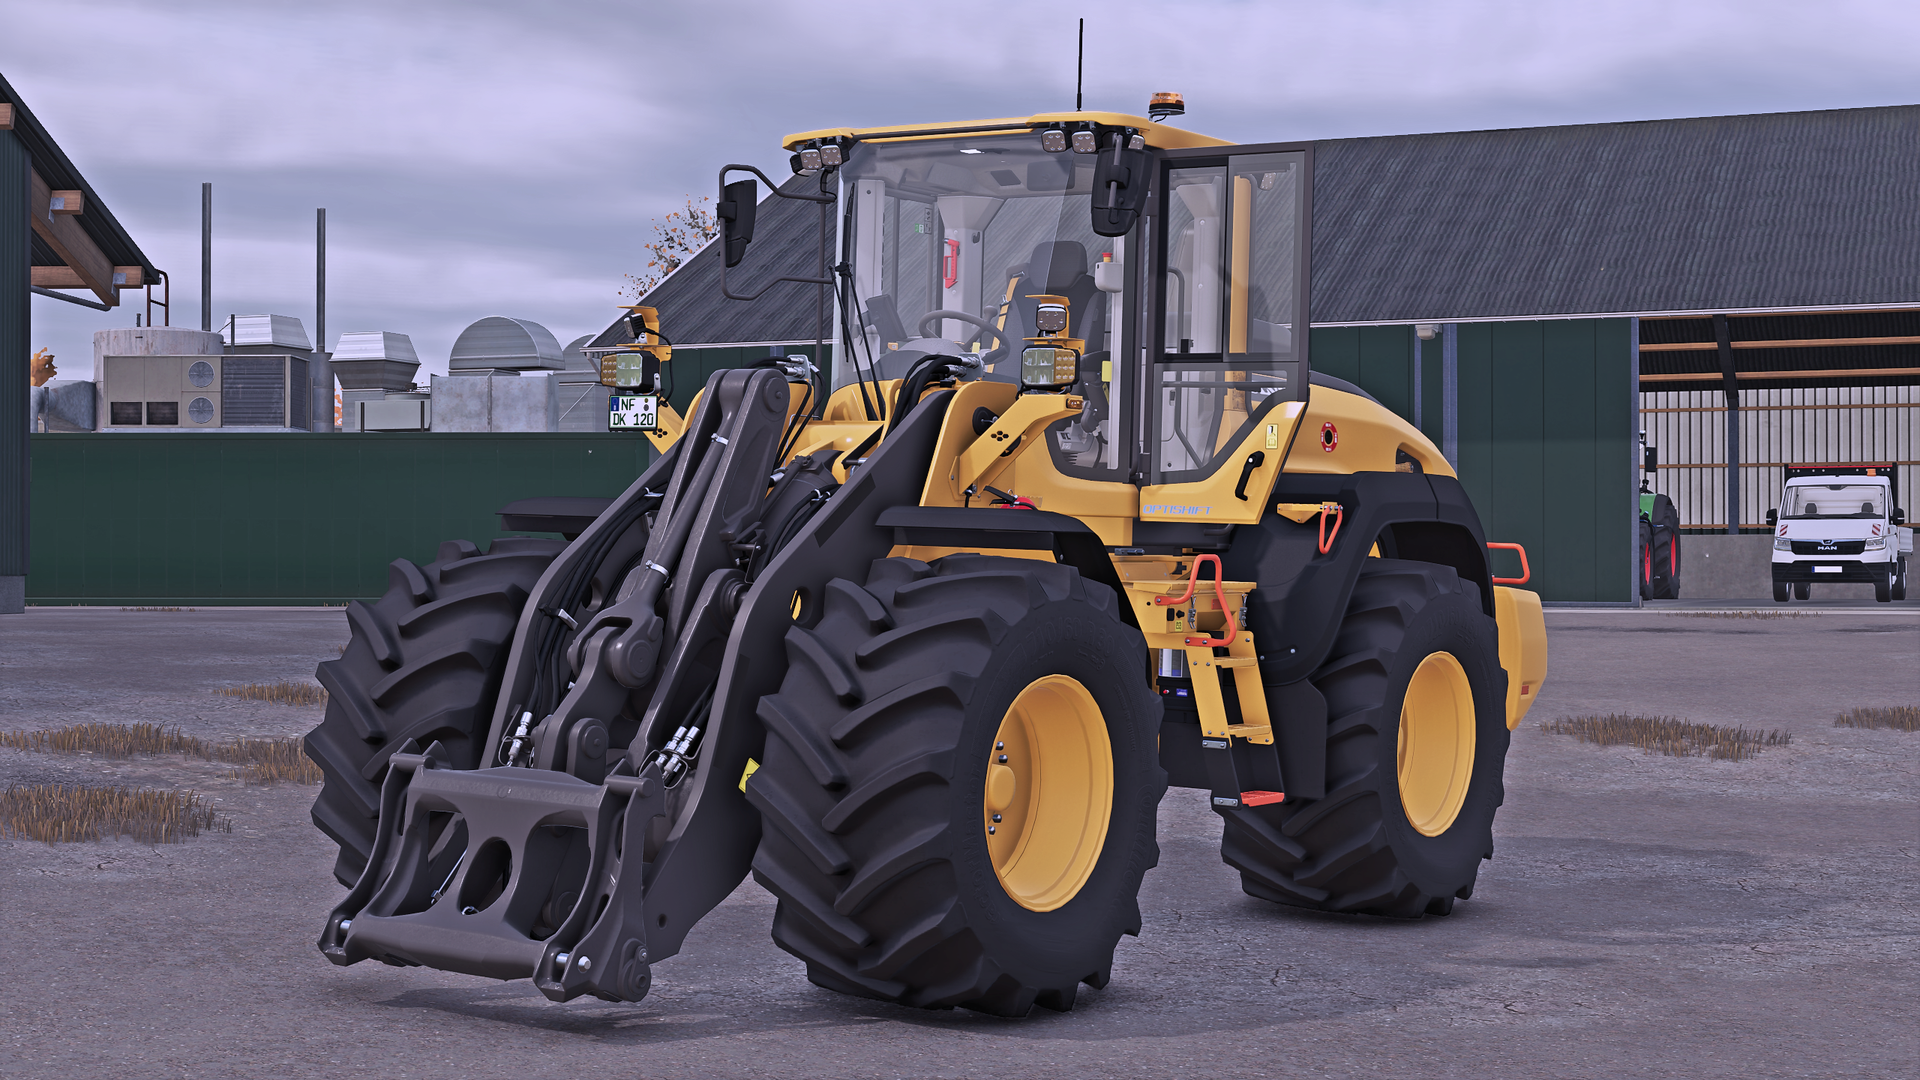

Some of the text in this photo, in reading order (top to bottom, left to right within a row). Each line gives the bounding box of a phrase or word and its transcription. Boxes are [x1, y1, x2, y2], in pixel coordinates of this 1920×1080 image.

[621, 399, 635, 410] NF
[613, 413, 654, 425] DK 120
[1143, 504, 1213, 515] OPTISHIFT
